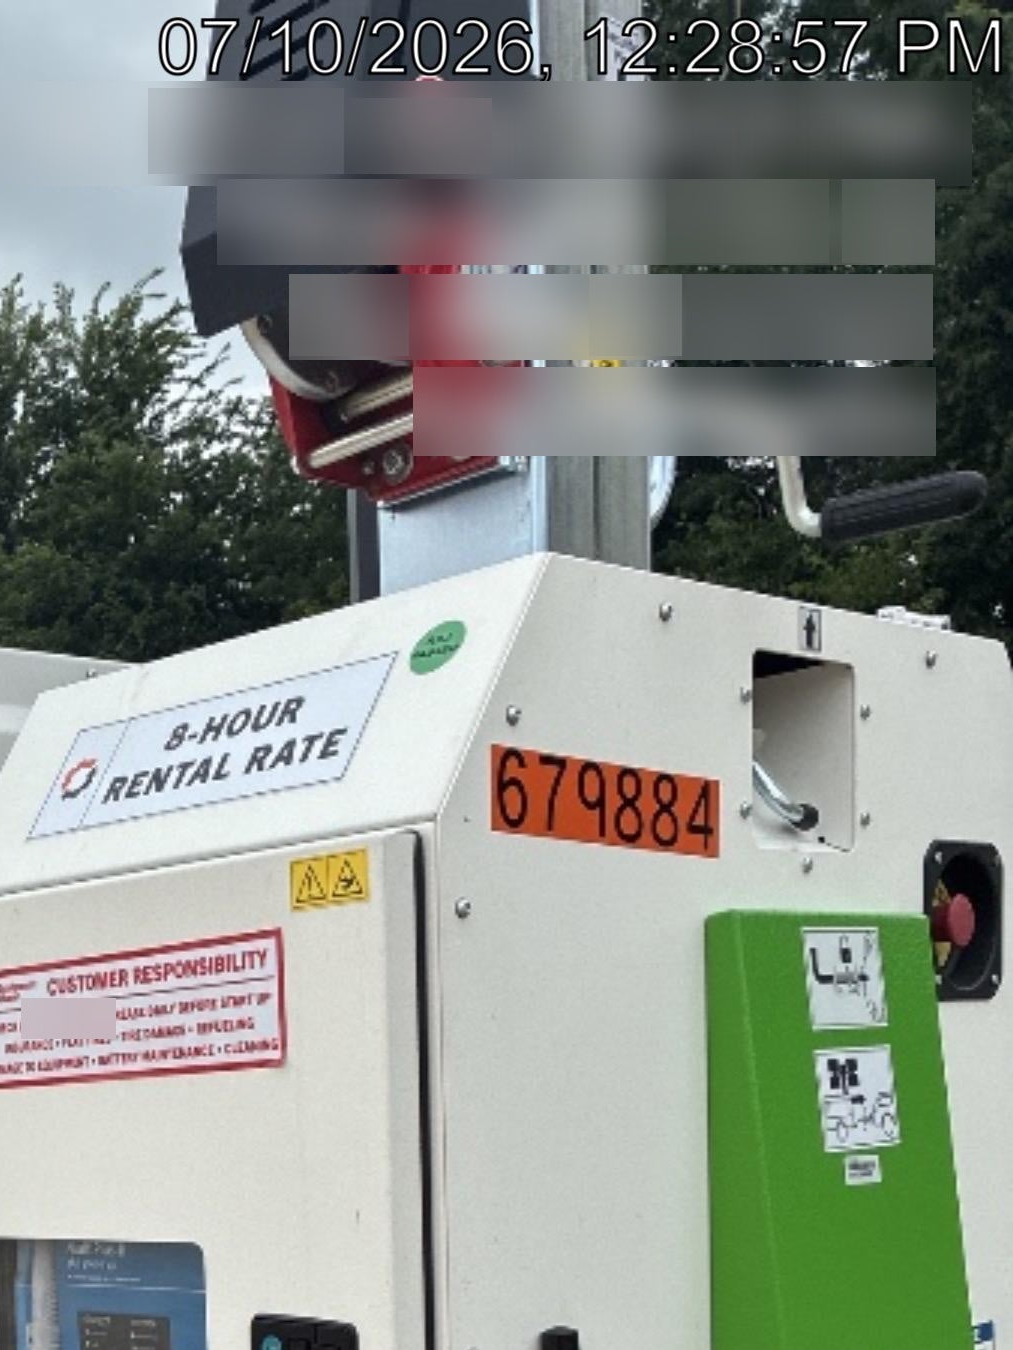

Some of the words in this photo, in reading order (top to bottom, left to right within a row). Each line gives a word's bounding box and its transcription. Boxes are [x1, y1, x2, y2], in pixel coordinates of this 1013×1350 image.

[163, 695, 306, 751] 8-HOUR
[101, 752, 231, 804] RENTAL
[244, 726, 349, 774] RATE
[496, 746, 714, 851] 679884
[46, 968, 129, 997] CUSTOMER
[133, 949, 269, 985] RESPONSIBILITY
